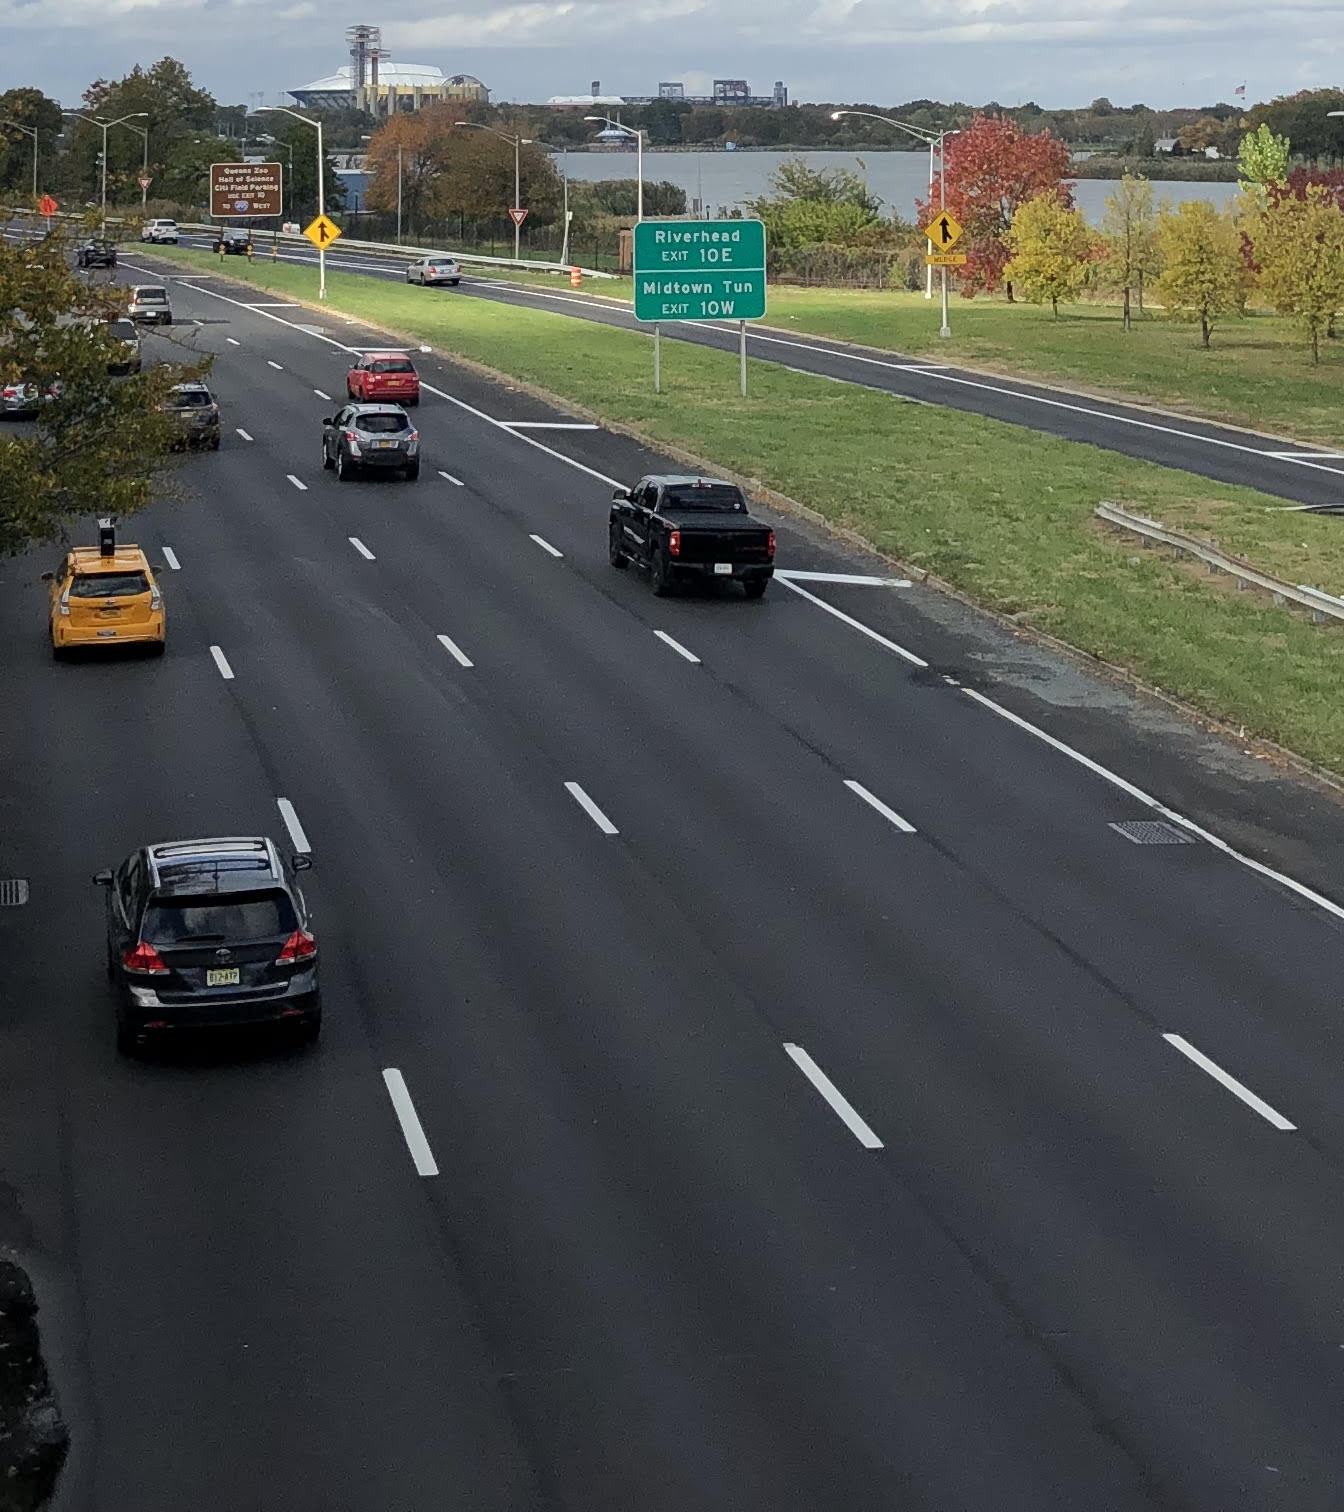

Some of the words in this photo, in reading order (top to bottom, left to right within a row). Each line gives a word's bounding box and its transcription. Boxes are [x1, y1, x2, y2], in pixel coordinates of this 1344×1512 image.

[655, 230, 740, 244] Riverhead
[661, 251, 689, 262] EXIT
[699, 247, 733, 262] 10E
[643, 281, 713, 294] Midtown
[722, 280, 753, 294] Tun
[662, 303, 690, 314] EXIT
[700, 300, 735, 315] 10W
